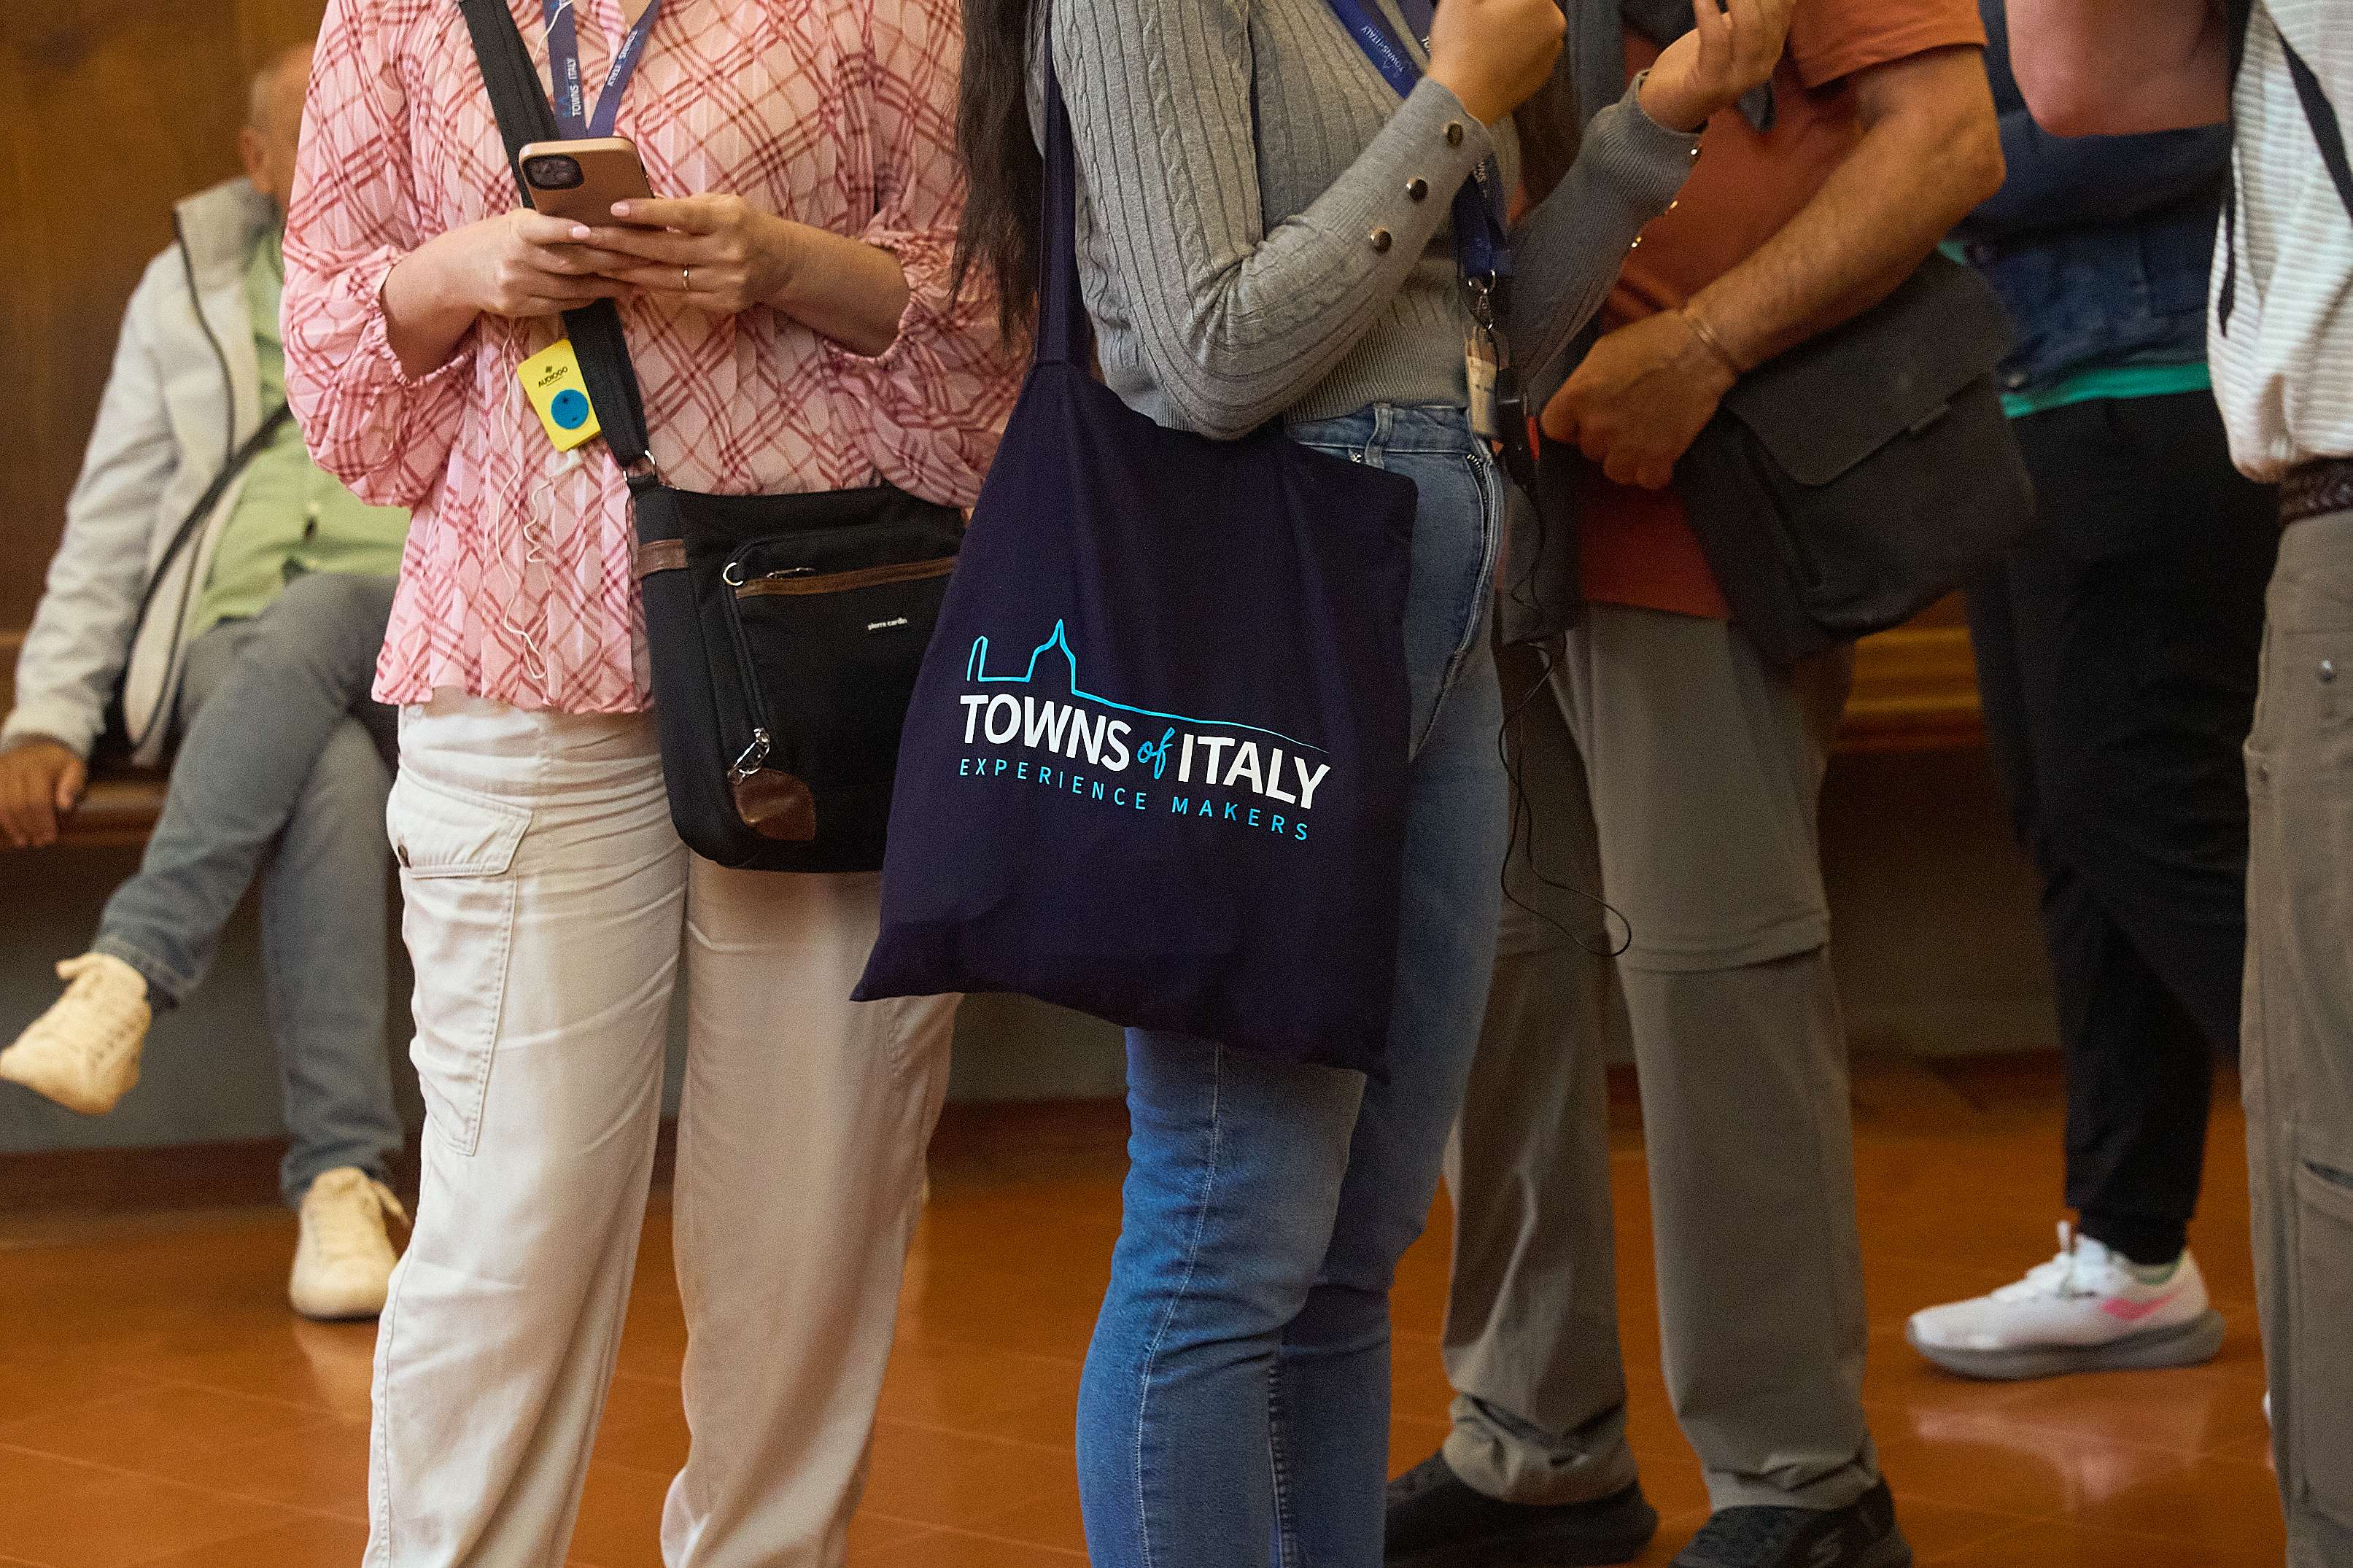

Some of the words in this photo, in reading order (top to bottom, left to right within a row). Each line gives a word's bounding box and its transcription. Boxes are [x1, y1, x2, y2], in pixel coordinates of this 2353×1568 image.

[566, 57, 578, 80] ITALY
[569, 85, 582, 117] TOWNS
[959, 693, 1132, 772] TOWNS
[1136, 726, 1176, 780] of
[1177, 733, 1331, 810] ITALY
[959, 758, 1147, 810] EXPERIENCE
[1171, 796, 1308, 841] MAKERS
